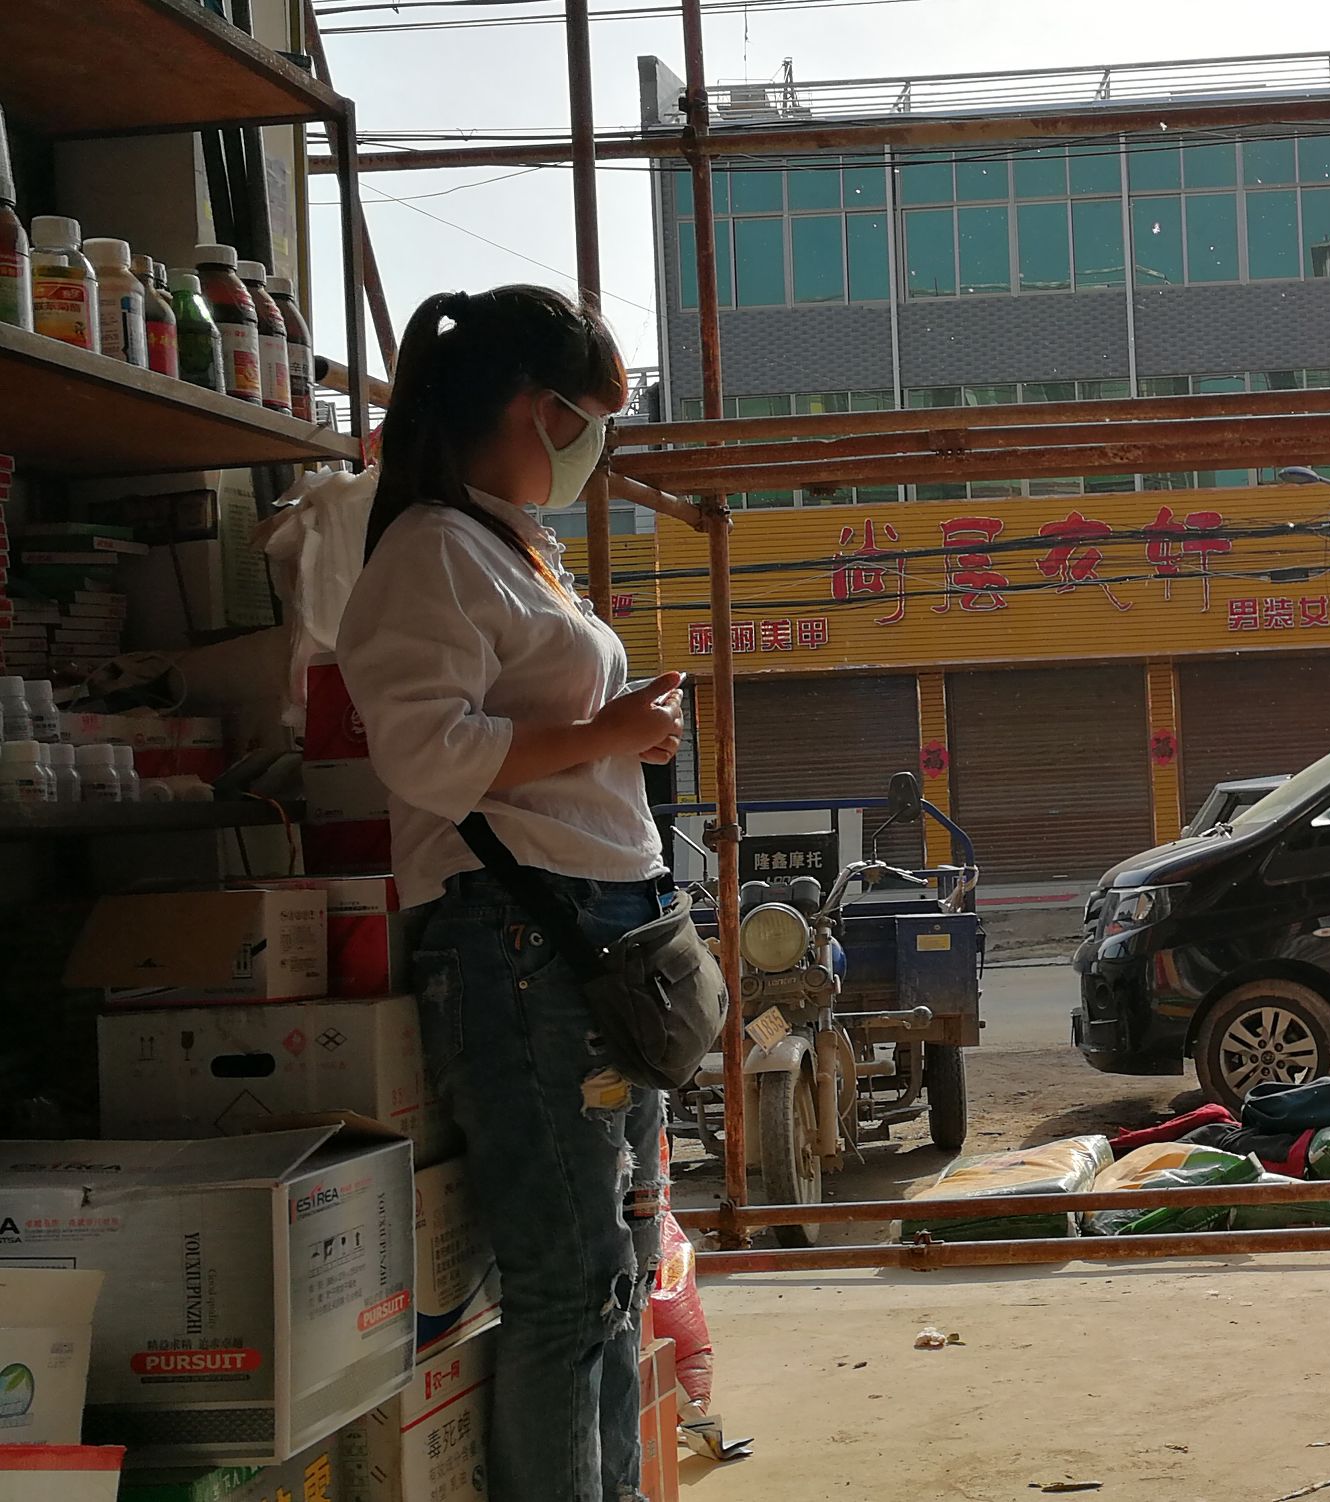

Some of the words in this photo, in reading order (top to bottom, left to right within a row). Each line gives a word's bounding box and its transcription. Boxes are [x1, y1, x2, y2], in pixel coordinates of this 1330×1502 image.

[687, 617, 829, 655] 丽丽美甲
[754, 851, 823, 870] 隆鑫摩托
[362, 1295, 406, 1328] PURSUIT
[145, 1353, 246, 1370] PURSUIT
[432, 1359, 461, 1391] 农一网
[426, 1408, 472, 1459] 毒死蜱
